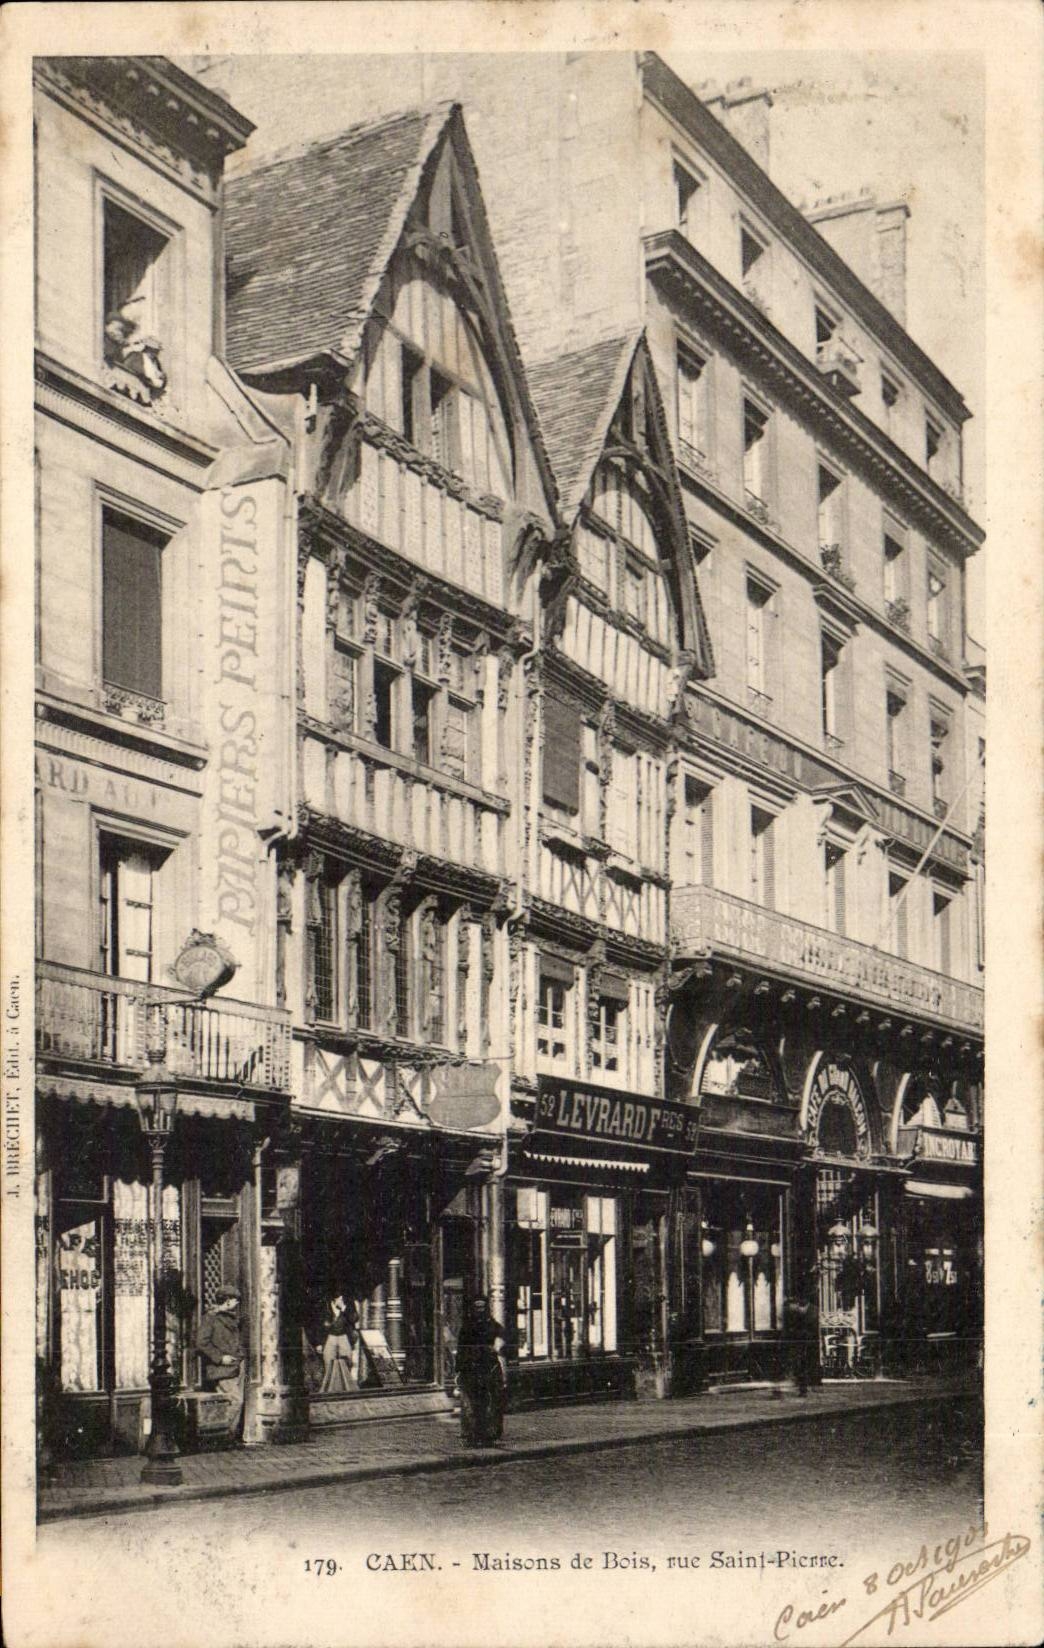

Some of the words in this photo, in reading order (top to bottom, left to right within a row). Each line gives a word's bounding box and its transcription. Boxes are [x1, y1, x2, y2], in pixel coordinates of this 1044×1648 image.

[213, 488, 260, 690] PEINTS
[213, 703, 260, 936] PAPIERS
[556, 1089, 646, 1139] LEVRARD
